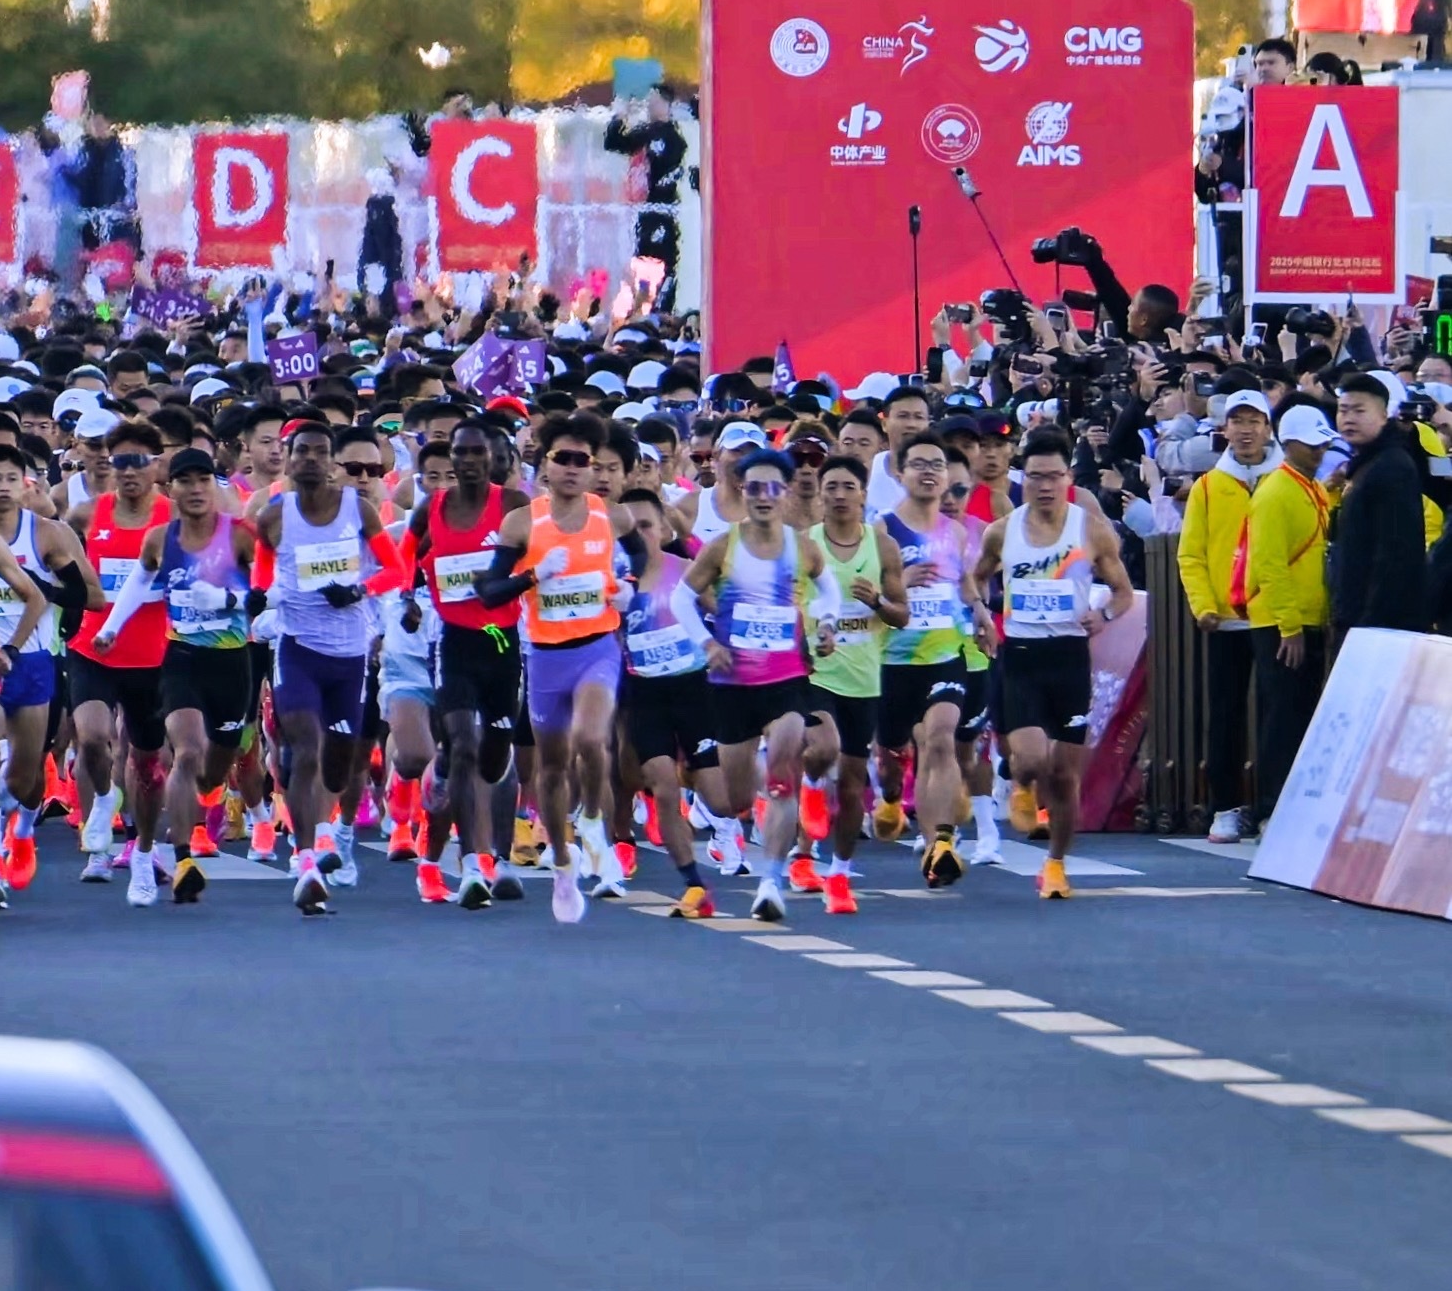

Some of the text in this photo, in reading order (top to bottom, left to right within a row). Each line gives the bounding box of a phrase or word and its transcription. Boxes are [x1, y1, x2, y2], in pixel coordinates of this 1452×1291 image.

[861, 37, 903, 48] CHINA
[1064, 26, 1142, 53] CMG
[829, 145, 886, 160] 中体产业
[1016, 144, 1082, 167] AIMS
[1278, 104, 1374, 218] A
[211, 145, 275, 228] D
[450, 135, 517, 226] C
[273, 352, 315, 379] 3:00
[310, 559, 349, 575] HAYLE
[541, 591, 599, 608] WANG JH
